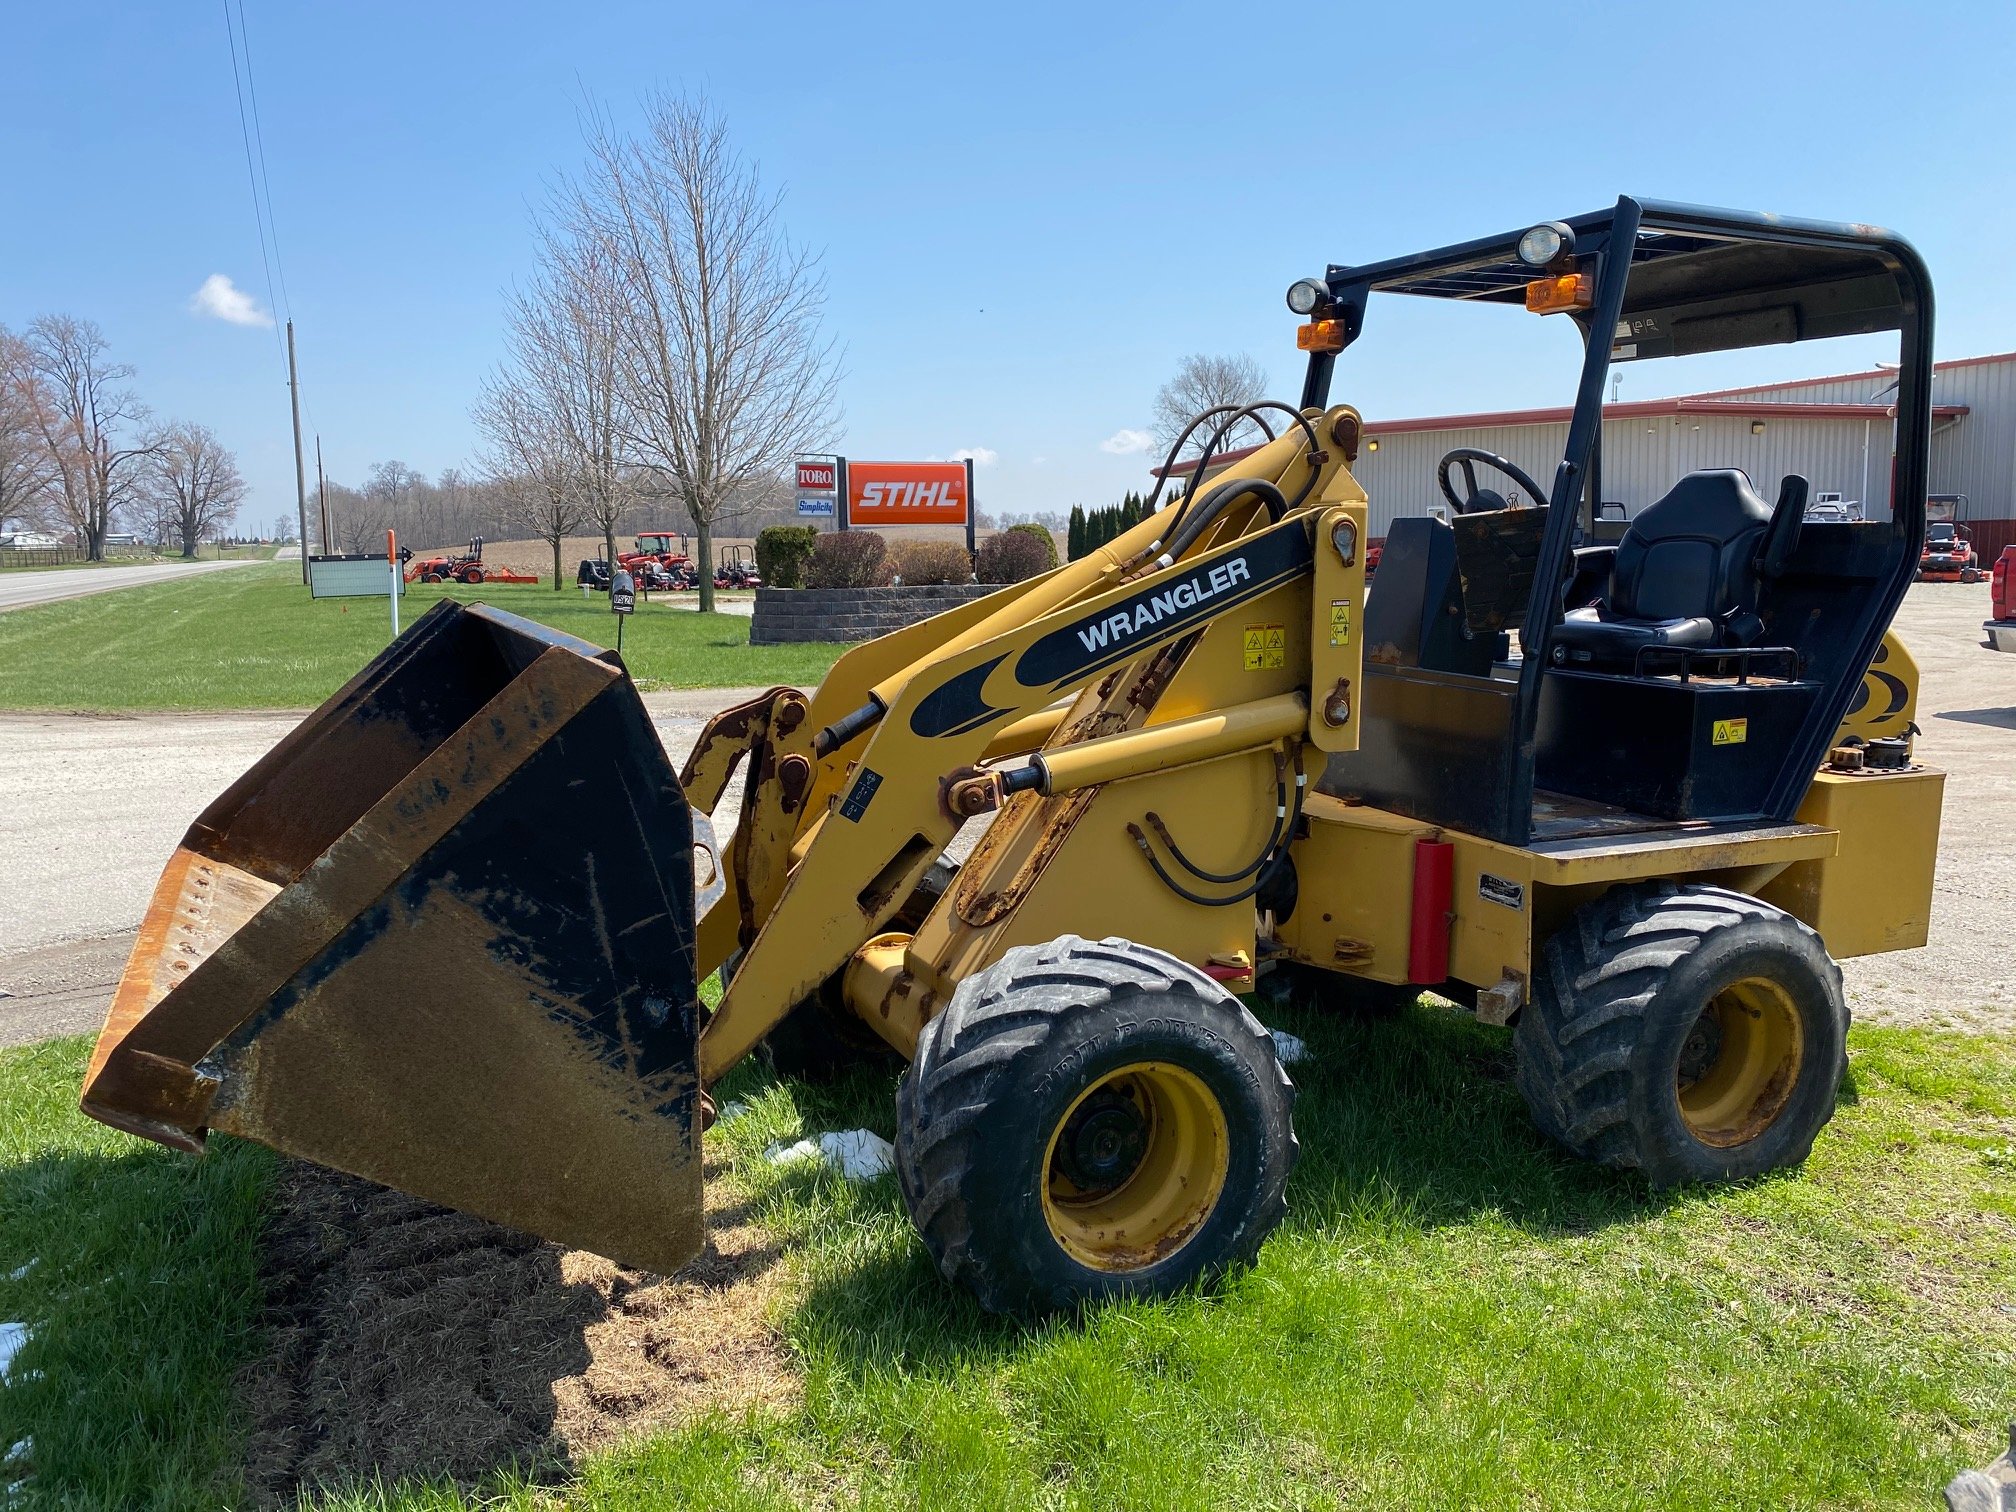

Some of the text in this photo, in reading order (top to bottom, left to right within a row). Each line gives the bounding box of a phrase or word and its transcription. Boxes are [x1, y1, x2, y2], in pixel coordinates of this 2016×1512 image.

[798, 501, 832, 514] Simplicity
[859, 482, 958, 507] STIHL
[1077, 557, 1251, 653] WRANGLER
[1114, 1016, 1238, 1061] POWER
